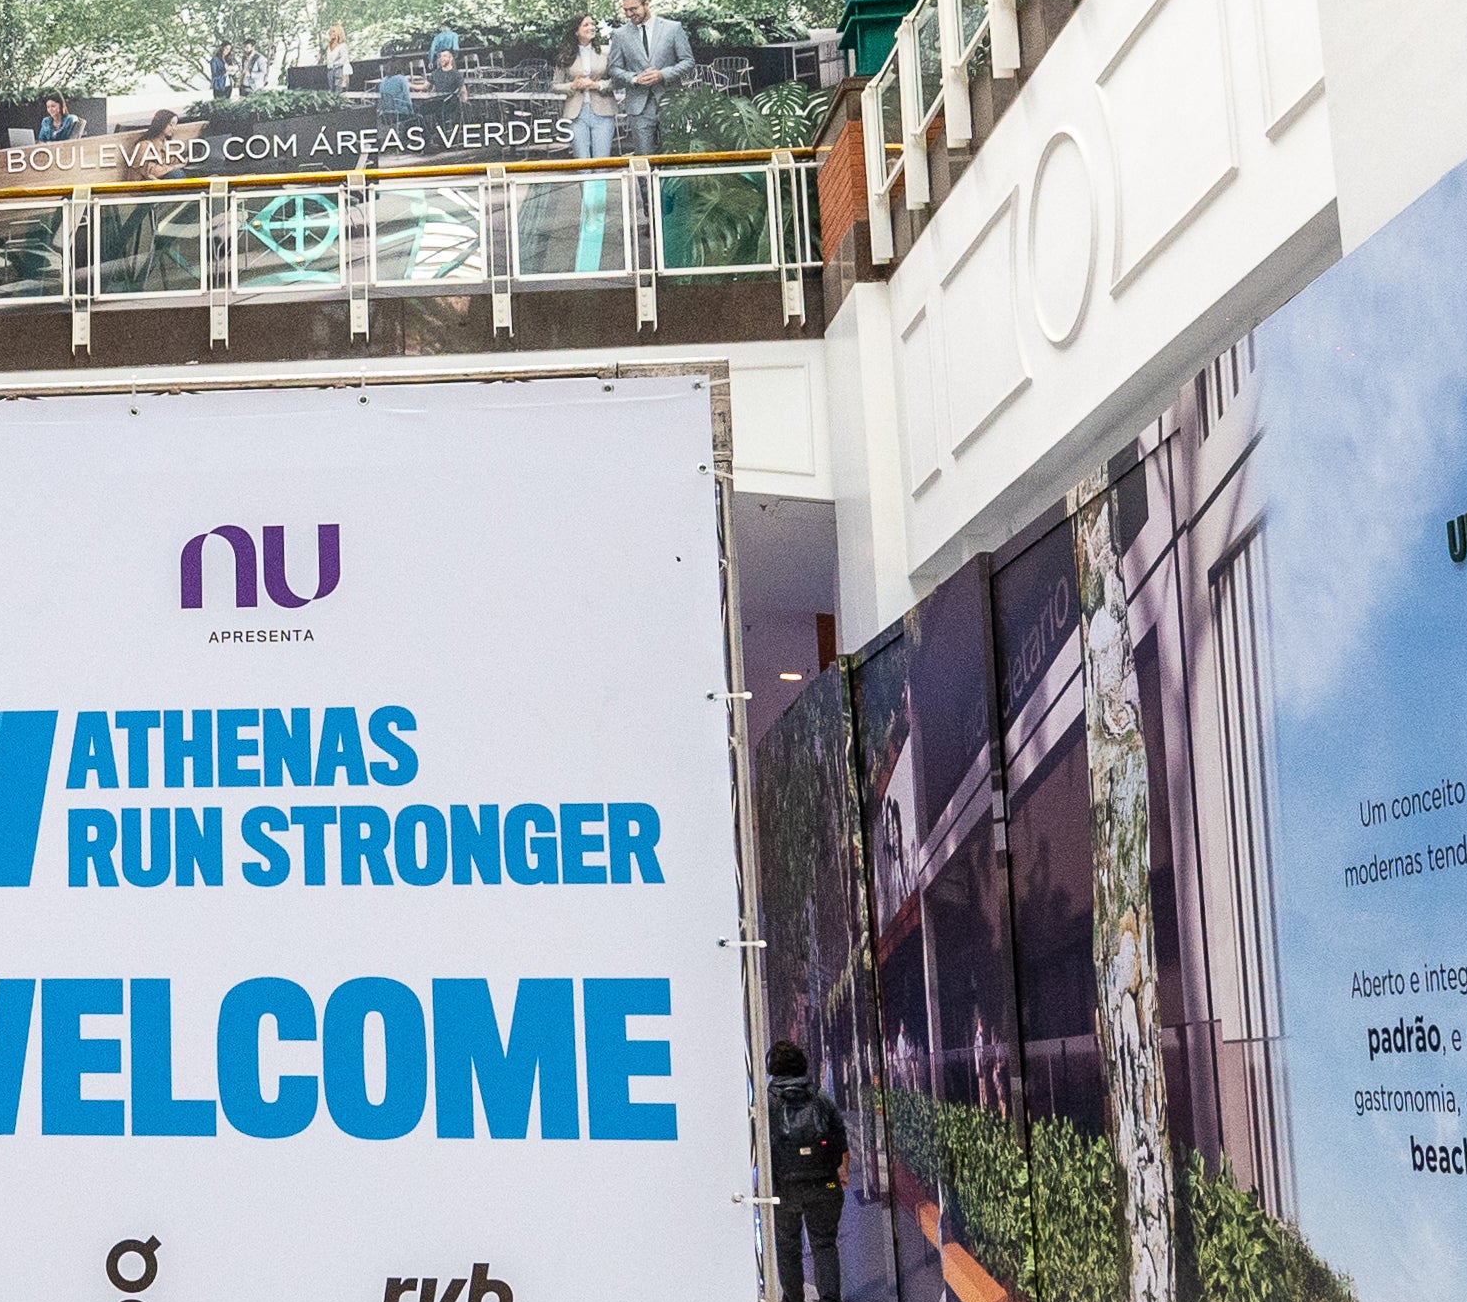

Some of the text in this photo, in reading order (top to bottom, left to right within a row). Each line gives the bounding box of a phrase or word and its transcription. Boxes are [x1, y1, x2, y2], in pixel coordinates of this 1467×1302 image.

[5, 116, 576, 174] BOULEVARD COM ÁREAS VERDES
[209, 629, 314, 643] APRESENTA
[66, 705, 419, 789] ATHENAS
[1360, 801, 1386, 827] Um
[1392, 780, 1465, 819] conceito
[68, 802, 665, 888] RUN STRONGER
[1345, 852, 1423, 886] modernas
[1352, 971, 1405, 997] Aberto
[1368, 1016, 1446, 1061] padrão,
[1355, 1086, 1460, 1116] gastronomia,
